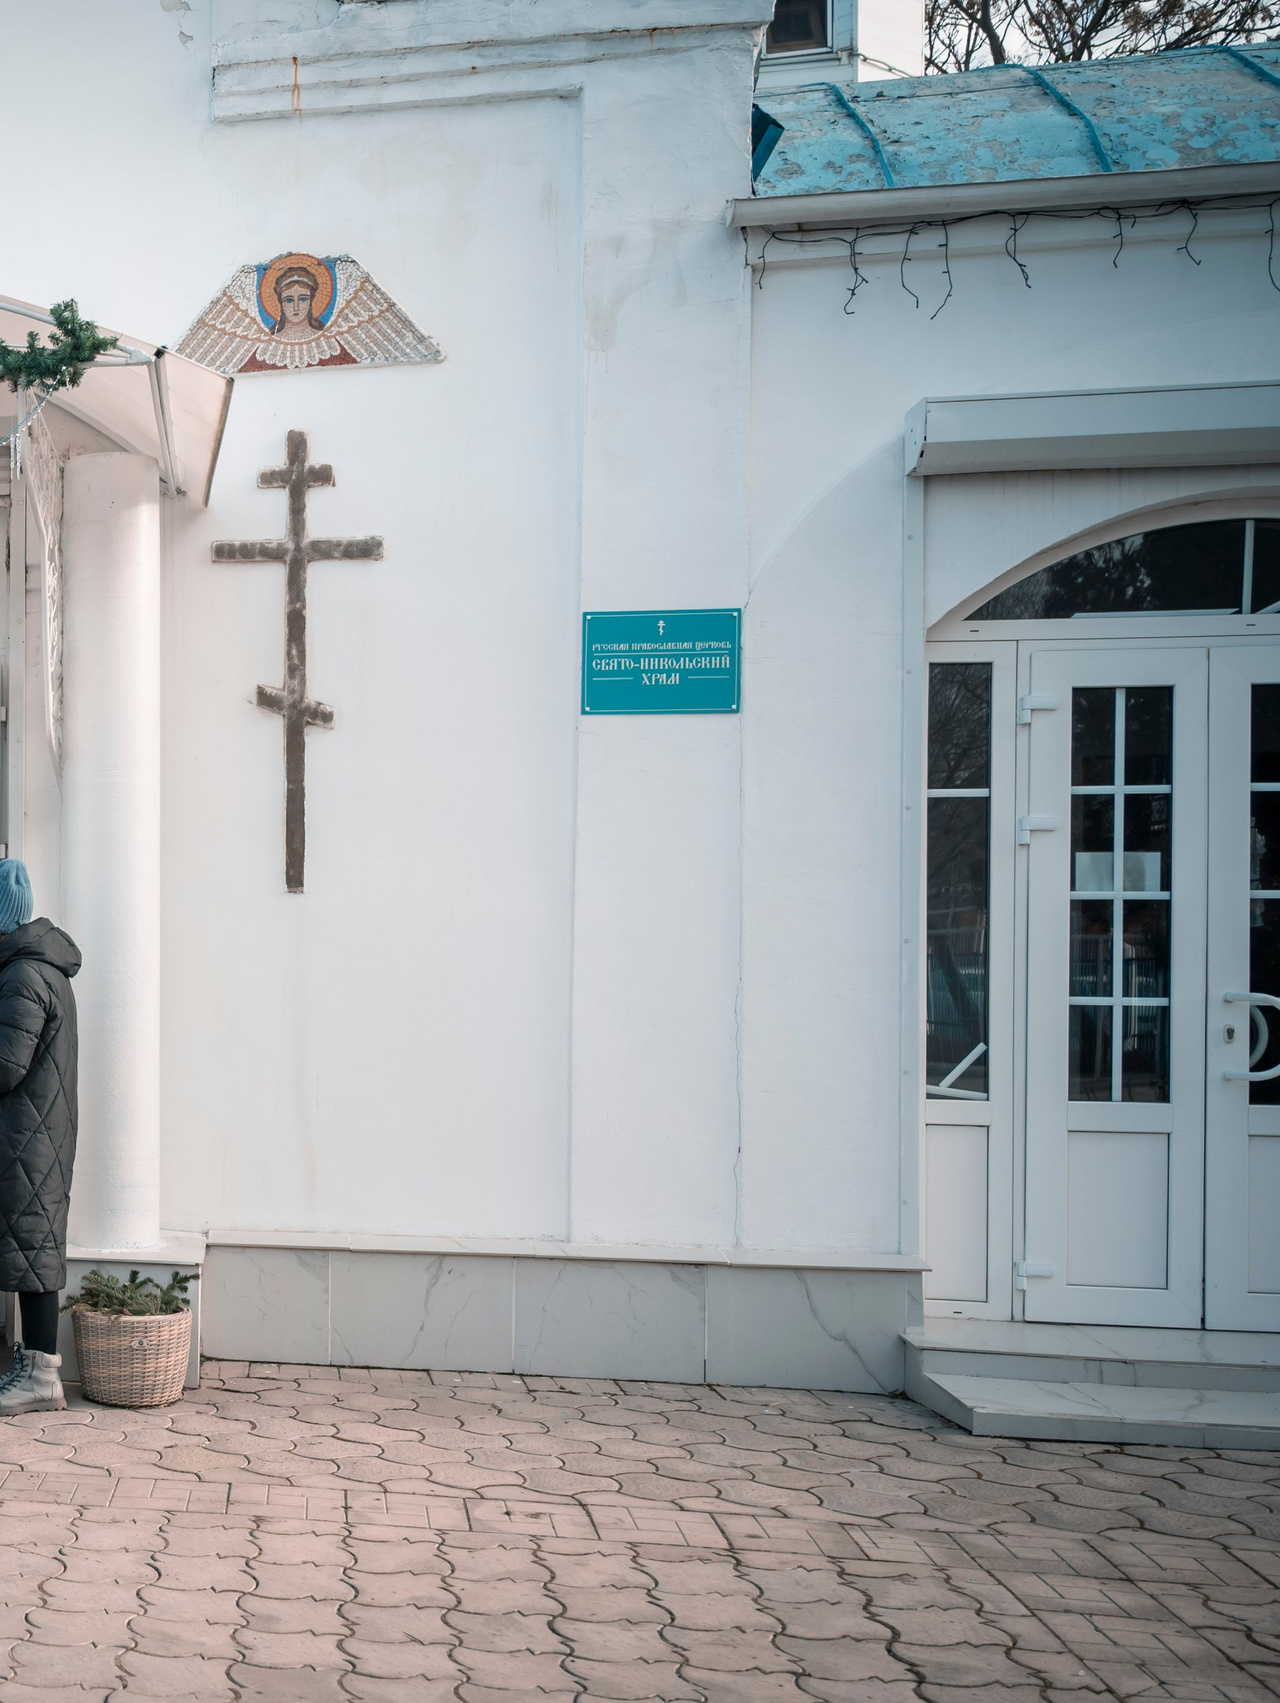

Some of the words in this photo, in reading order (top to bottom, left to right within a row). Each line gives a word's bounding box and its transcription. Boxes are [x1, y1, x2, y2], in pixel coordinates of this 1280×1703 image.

[592, 643, 629, 651] РУССКАЯ
[631, 641, 692, 651] ПРАВОСЛАВНАЯ
[695, 640, 732, 651] ЦЕРКОВЬ
[592, 655, 730, 671] СВЯТО-НИКОЛЬСКИЙ
[641, 672, 680, 685] ХРАМ
